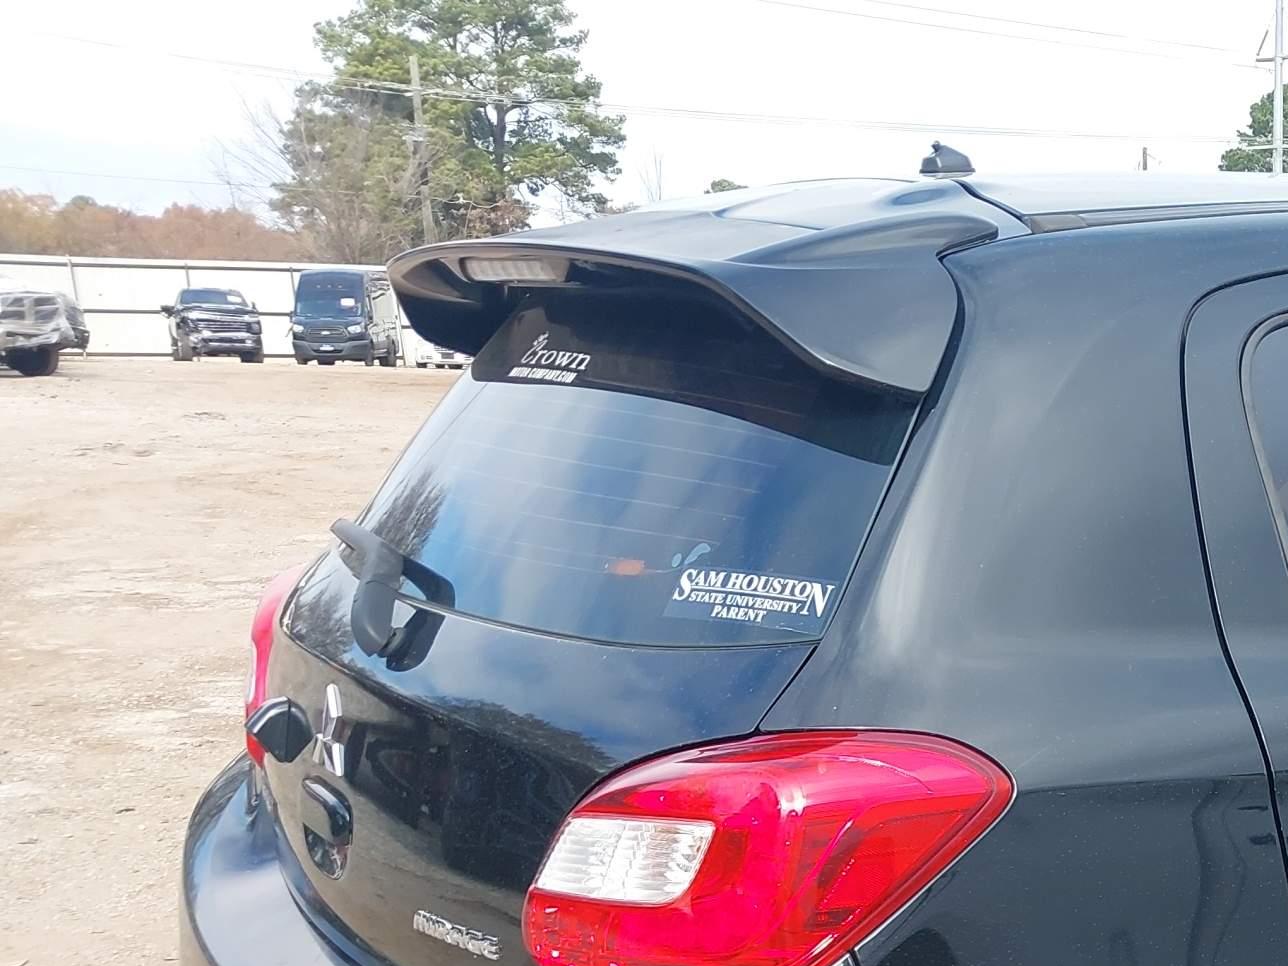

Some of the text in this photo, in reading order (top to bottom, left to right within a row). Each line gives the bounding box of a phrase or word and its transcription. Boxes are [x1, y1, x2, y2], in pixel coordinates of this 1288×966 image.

[520, 338, 591, 370] Crown
[673, 569, 836, 617] SAM HOUSTON
[688, 590, 803, 613] STATE UNIVERSITY
[710, 605, 768, 622] PARENT
[413, 910, 499, 960] MIRAGE
